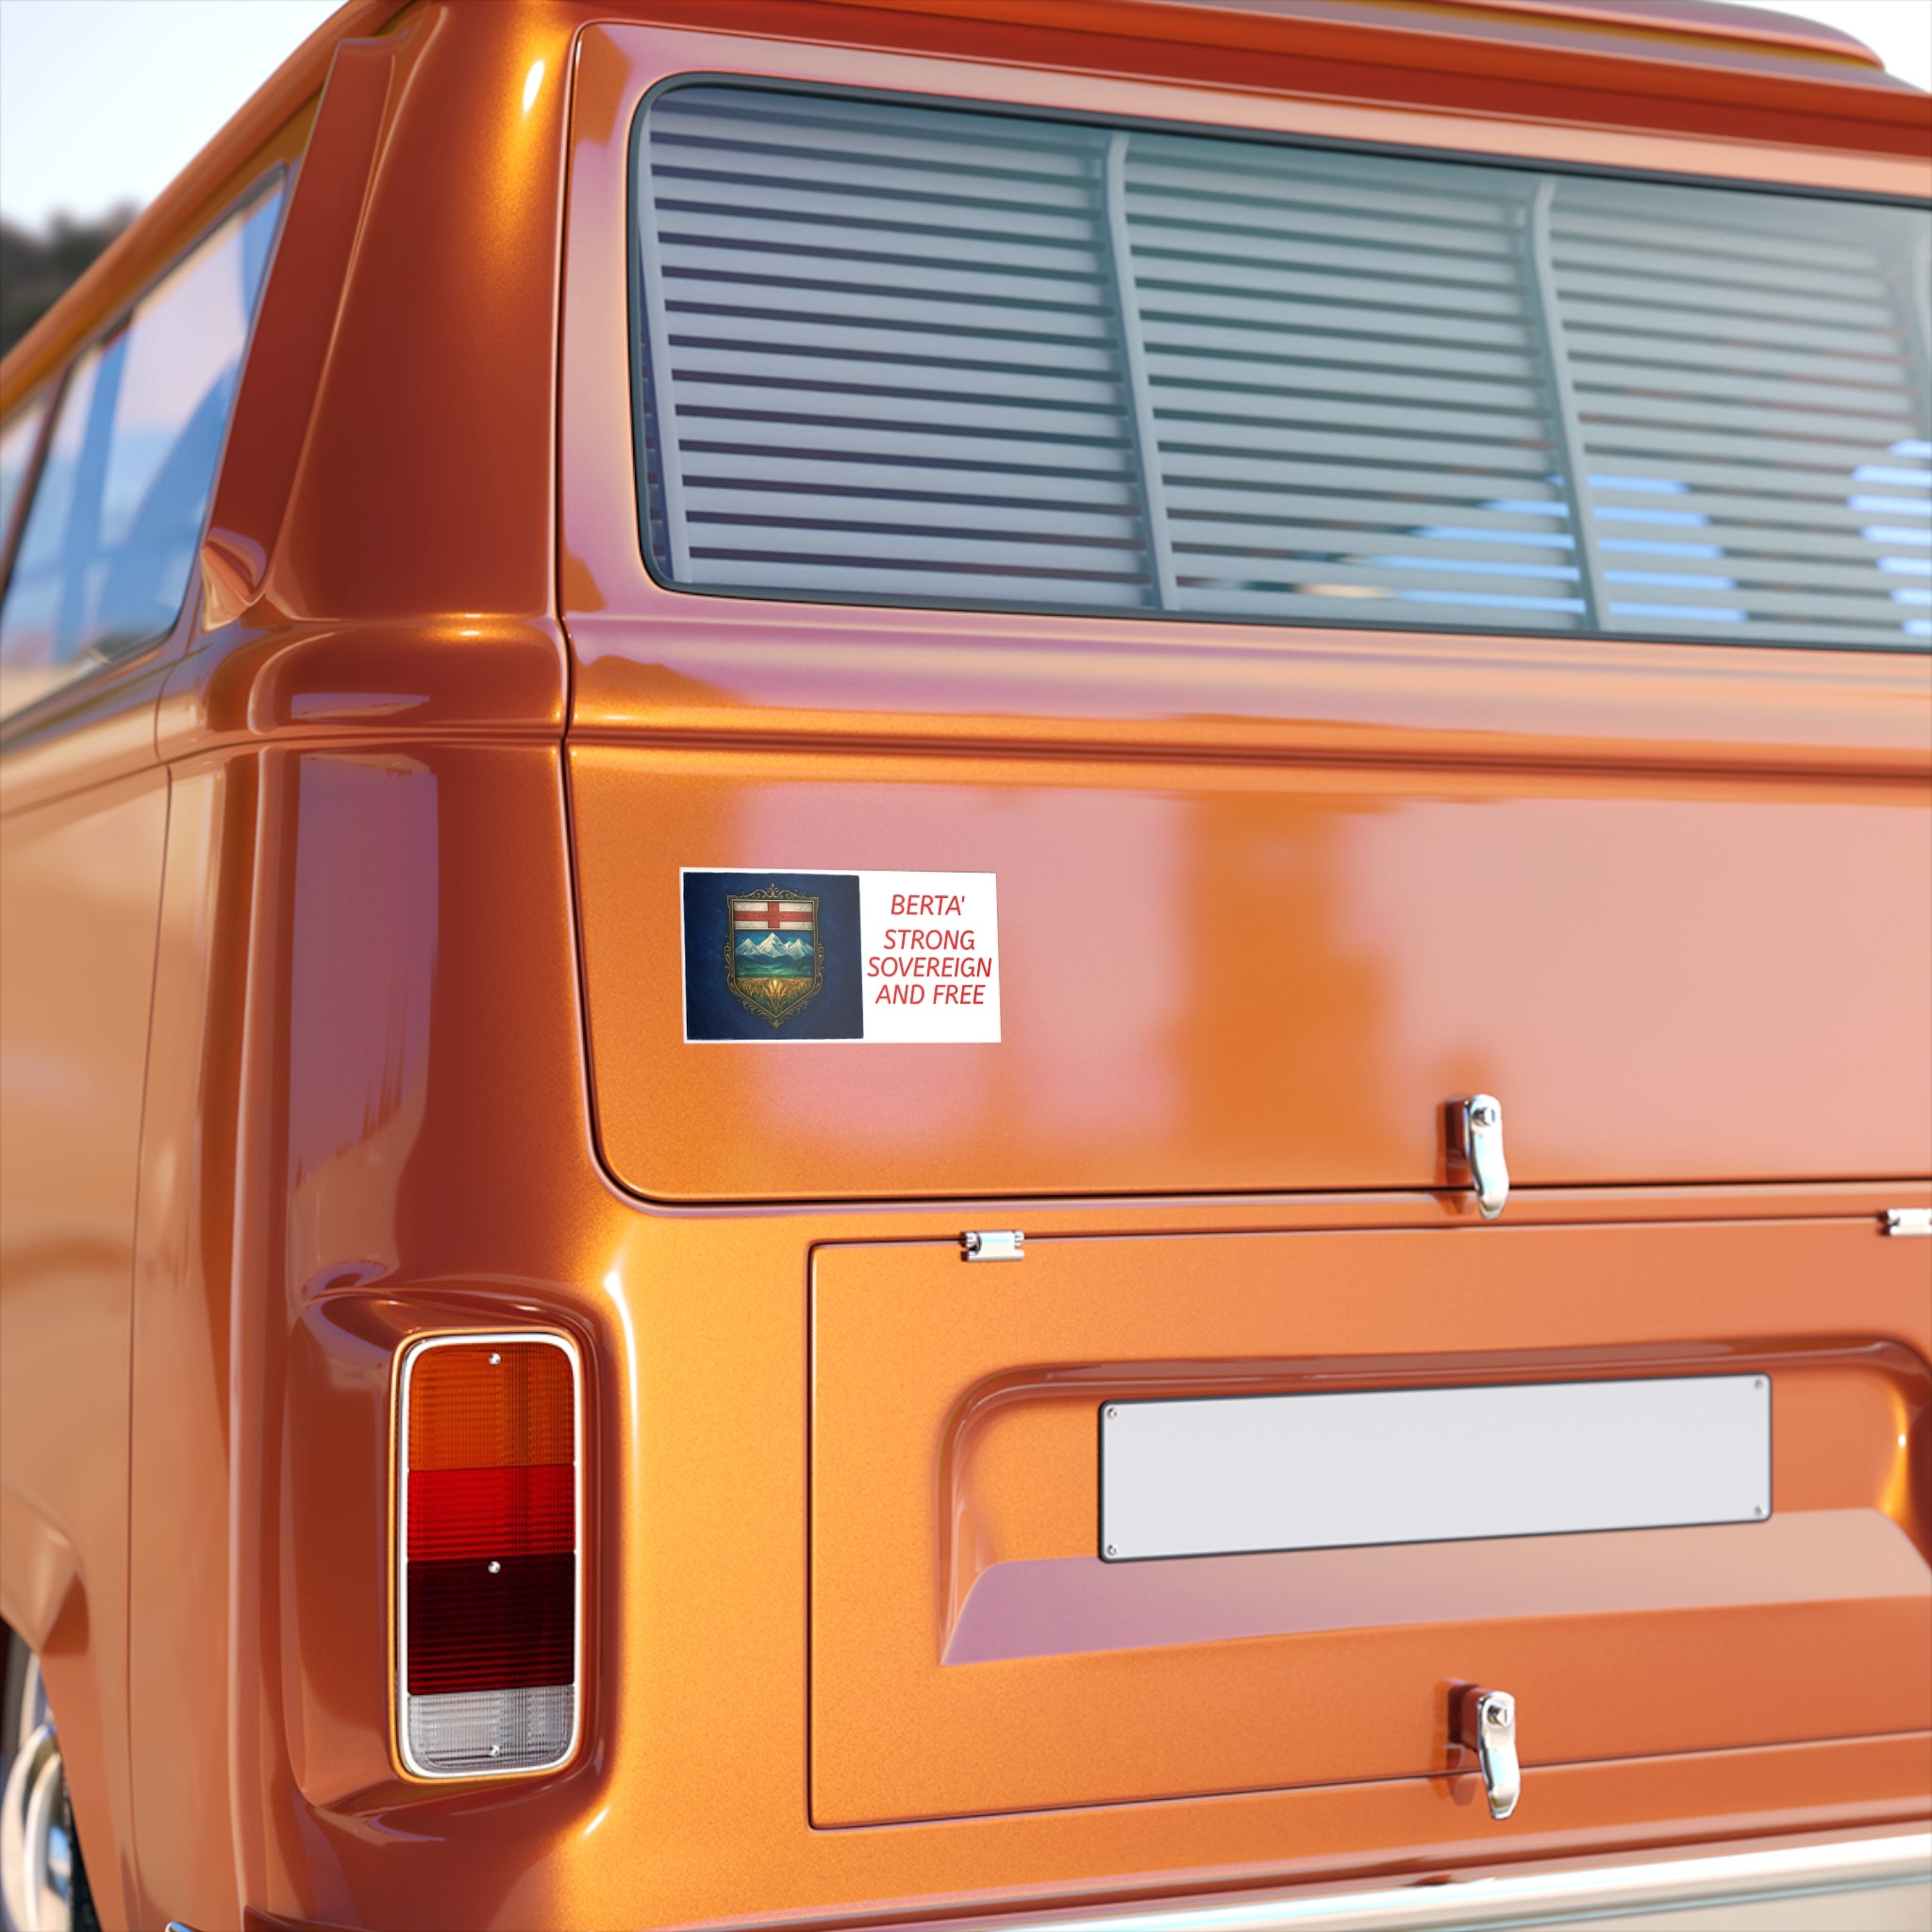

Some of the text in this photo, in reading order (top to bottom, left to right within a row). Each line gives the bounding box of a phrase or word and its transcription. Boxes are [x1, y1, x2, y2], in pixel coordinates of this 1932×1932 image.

[891, 894, 965, 916] BERTA'
[884, 929, 974, 950] STRONG
[868, 957, 991, 977] SOVEREIGN
[875, 984, 986, 1005] AND FREE
